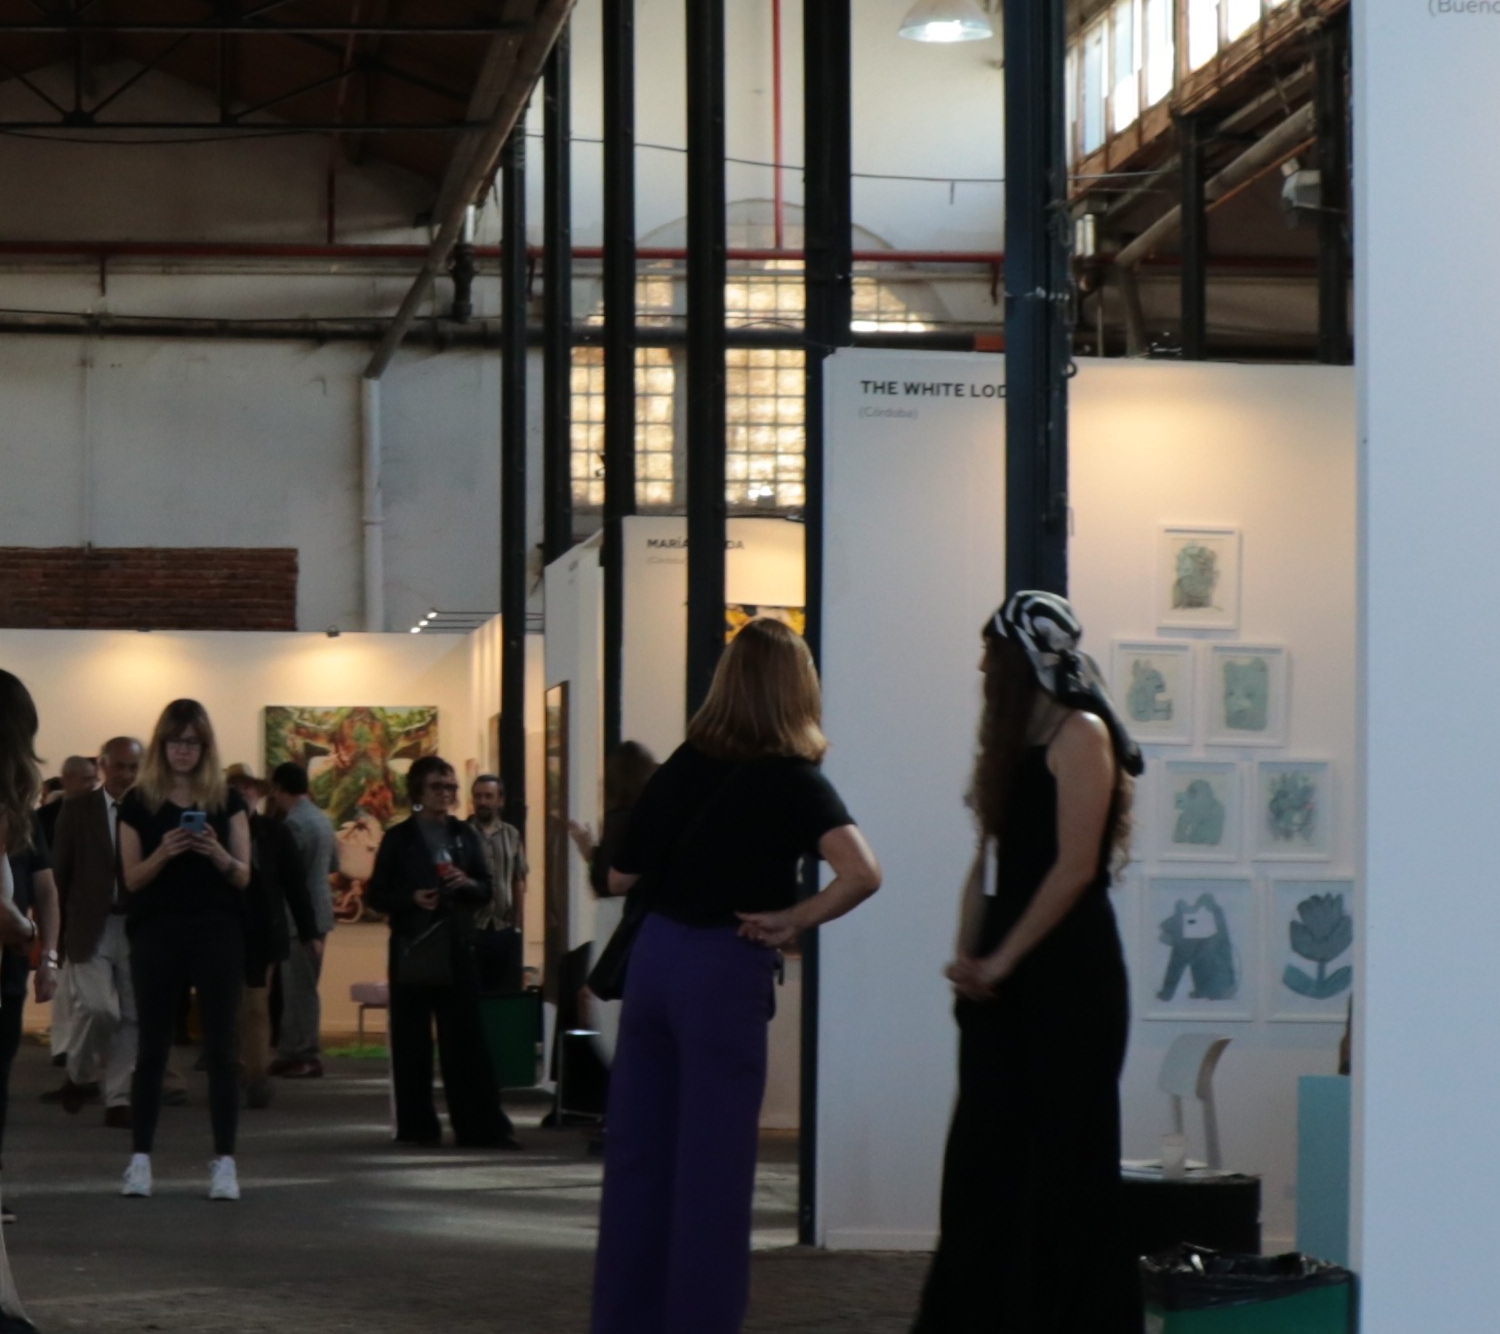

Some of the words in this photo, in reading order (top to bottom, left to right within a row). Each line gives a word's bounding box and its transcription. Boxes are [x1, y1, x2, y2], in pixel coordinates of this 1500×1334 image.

[860, 380, 898, 395] THE
[904, 382, 965, 397] WHITE
[970, 384, 1007, 398] LOD
